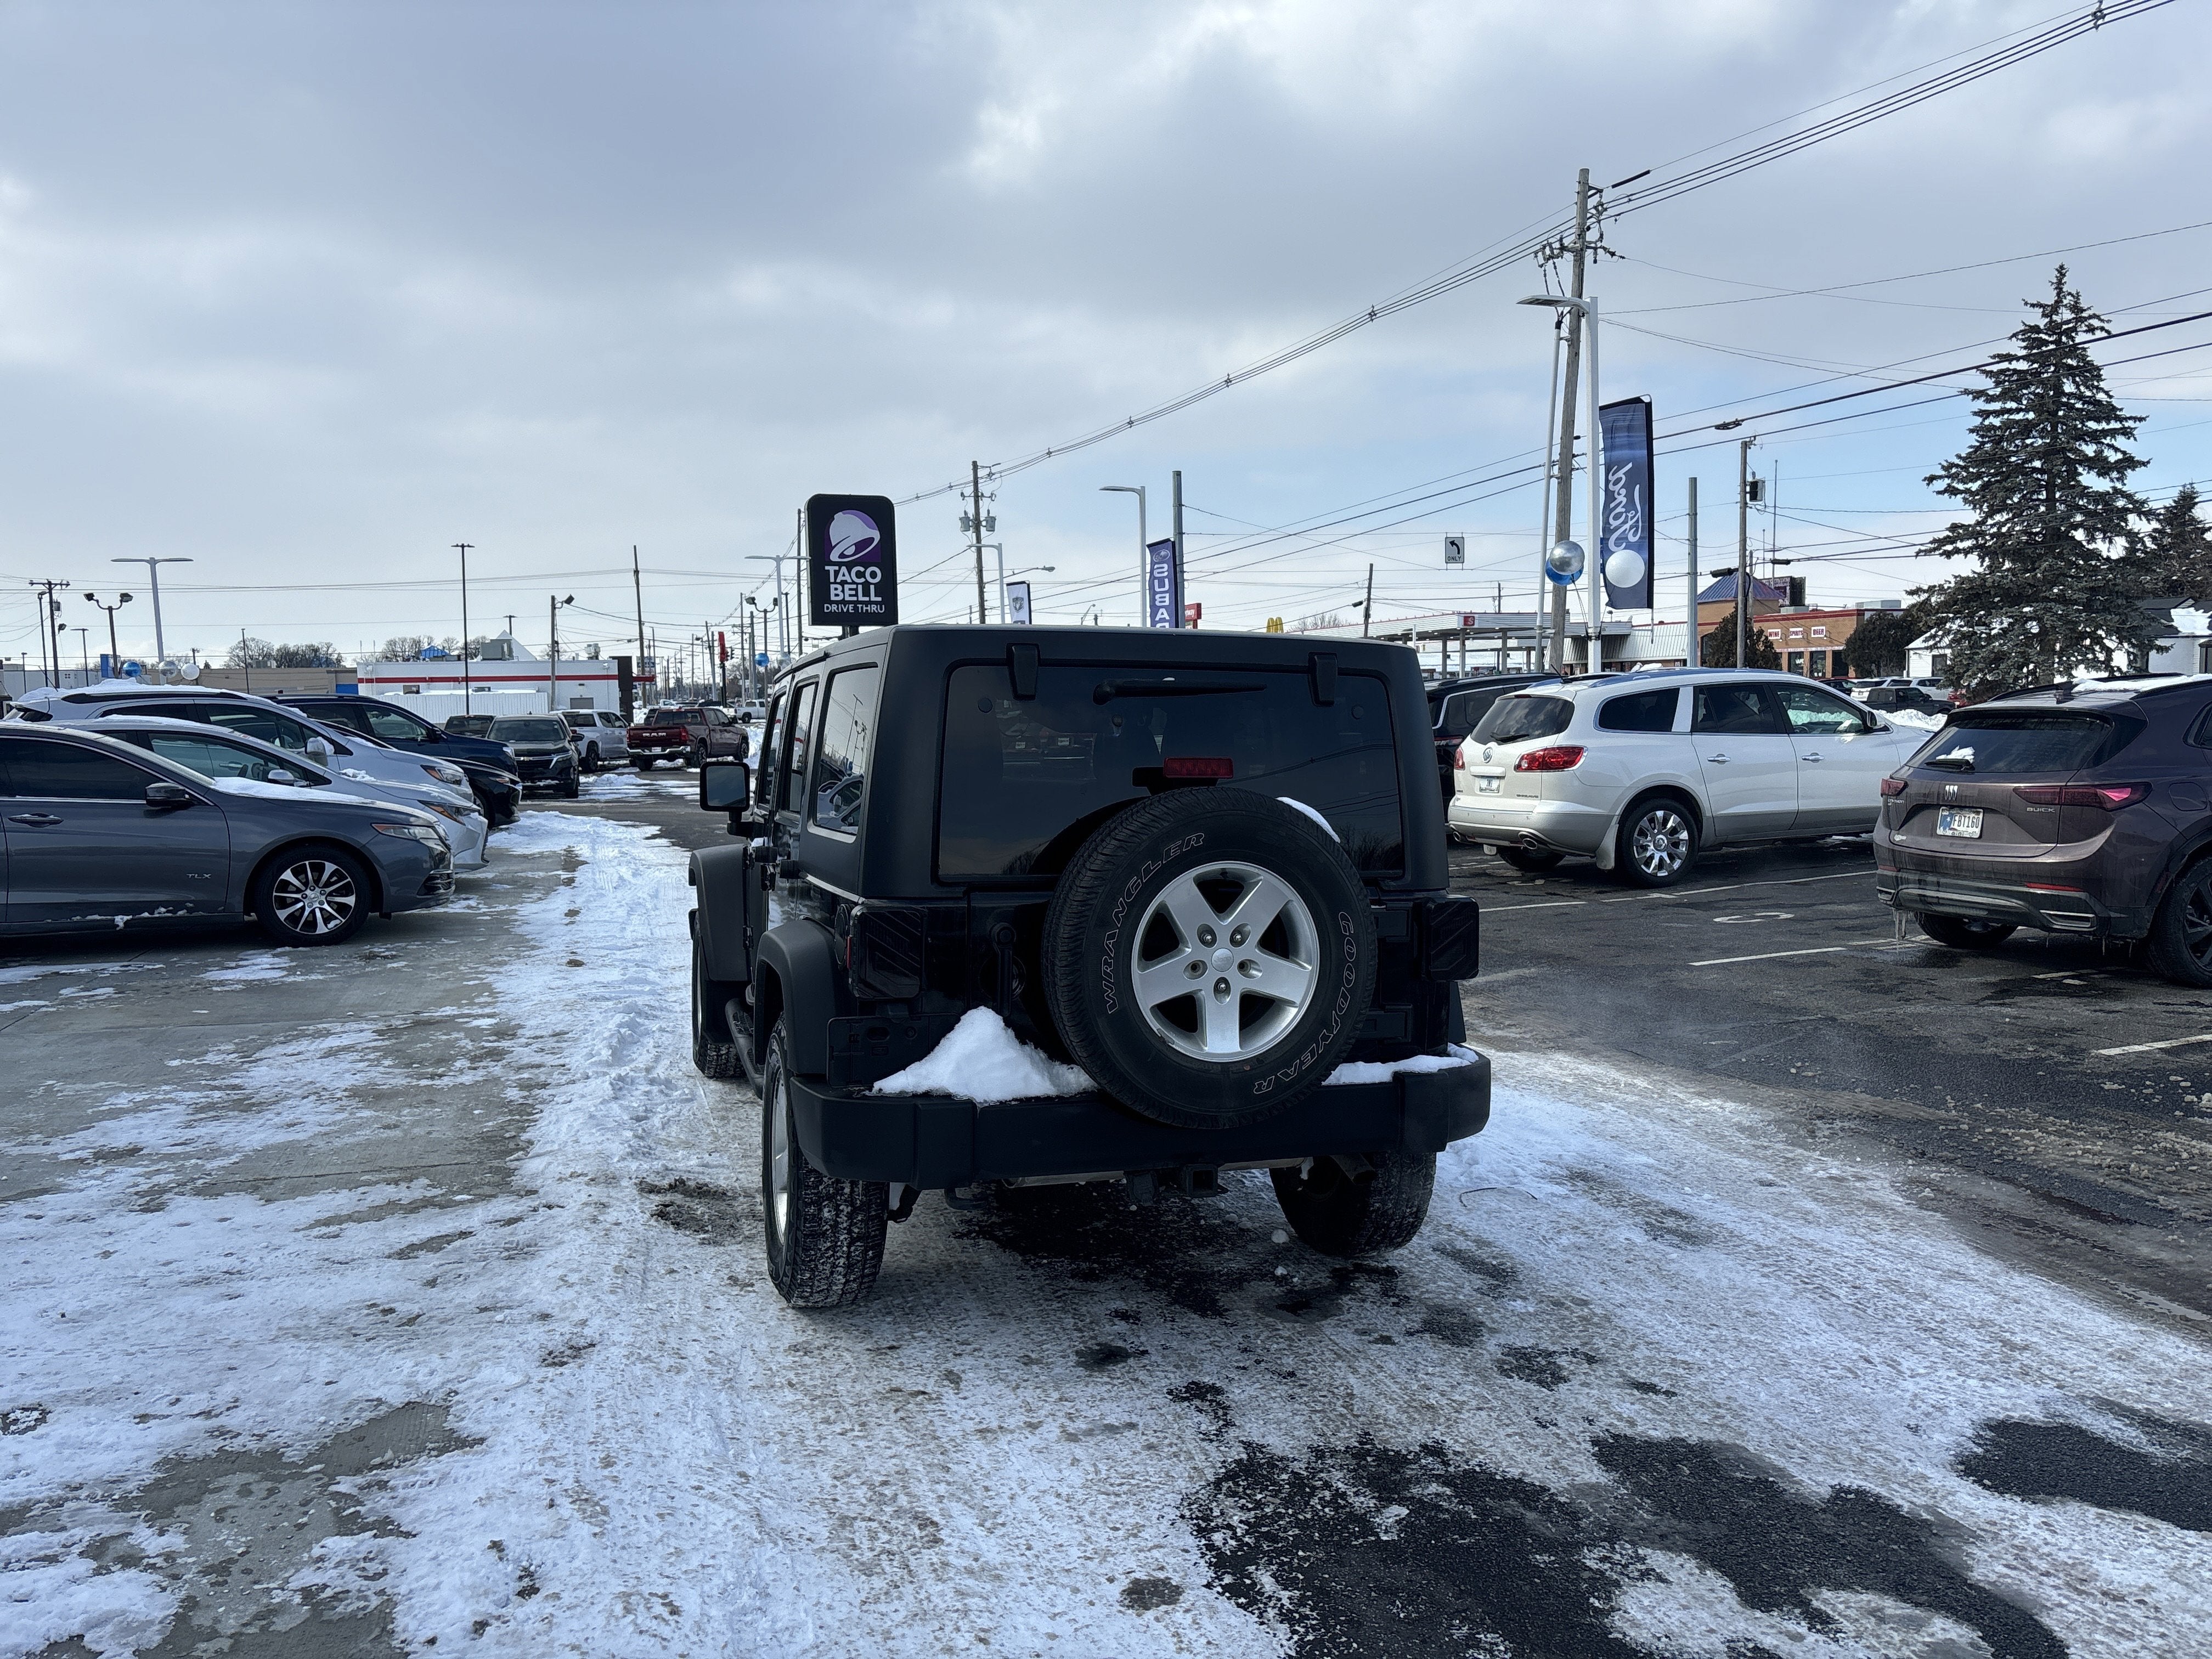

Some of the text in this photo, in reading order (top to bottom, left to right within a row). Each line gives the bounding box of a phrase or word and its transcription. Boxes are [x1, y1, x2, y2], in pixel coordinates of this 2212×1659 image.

[825, 566, 882, 583] TACO
[830, 584, 882, 601] BELL
[824, 603, 885, 613] DRIVE THRU
[1953, 815, 1980, 828] FBT160
[1102, 833, 1205, 1014] WRANGLER
[1254, 912, 1356, 1094] GOODYEAR
